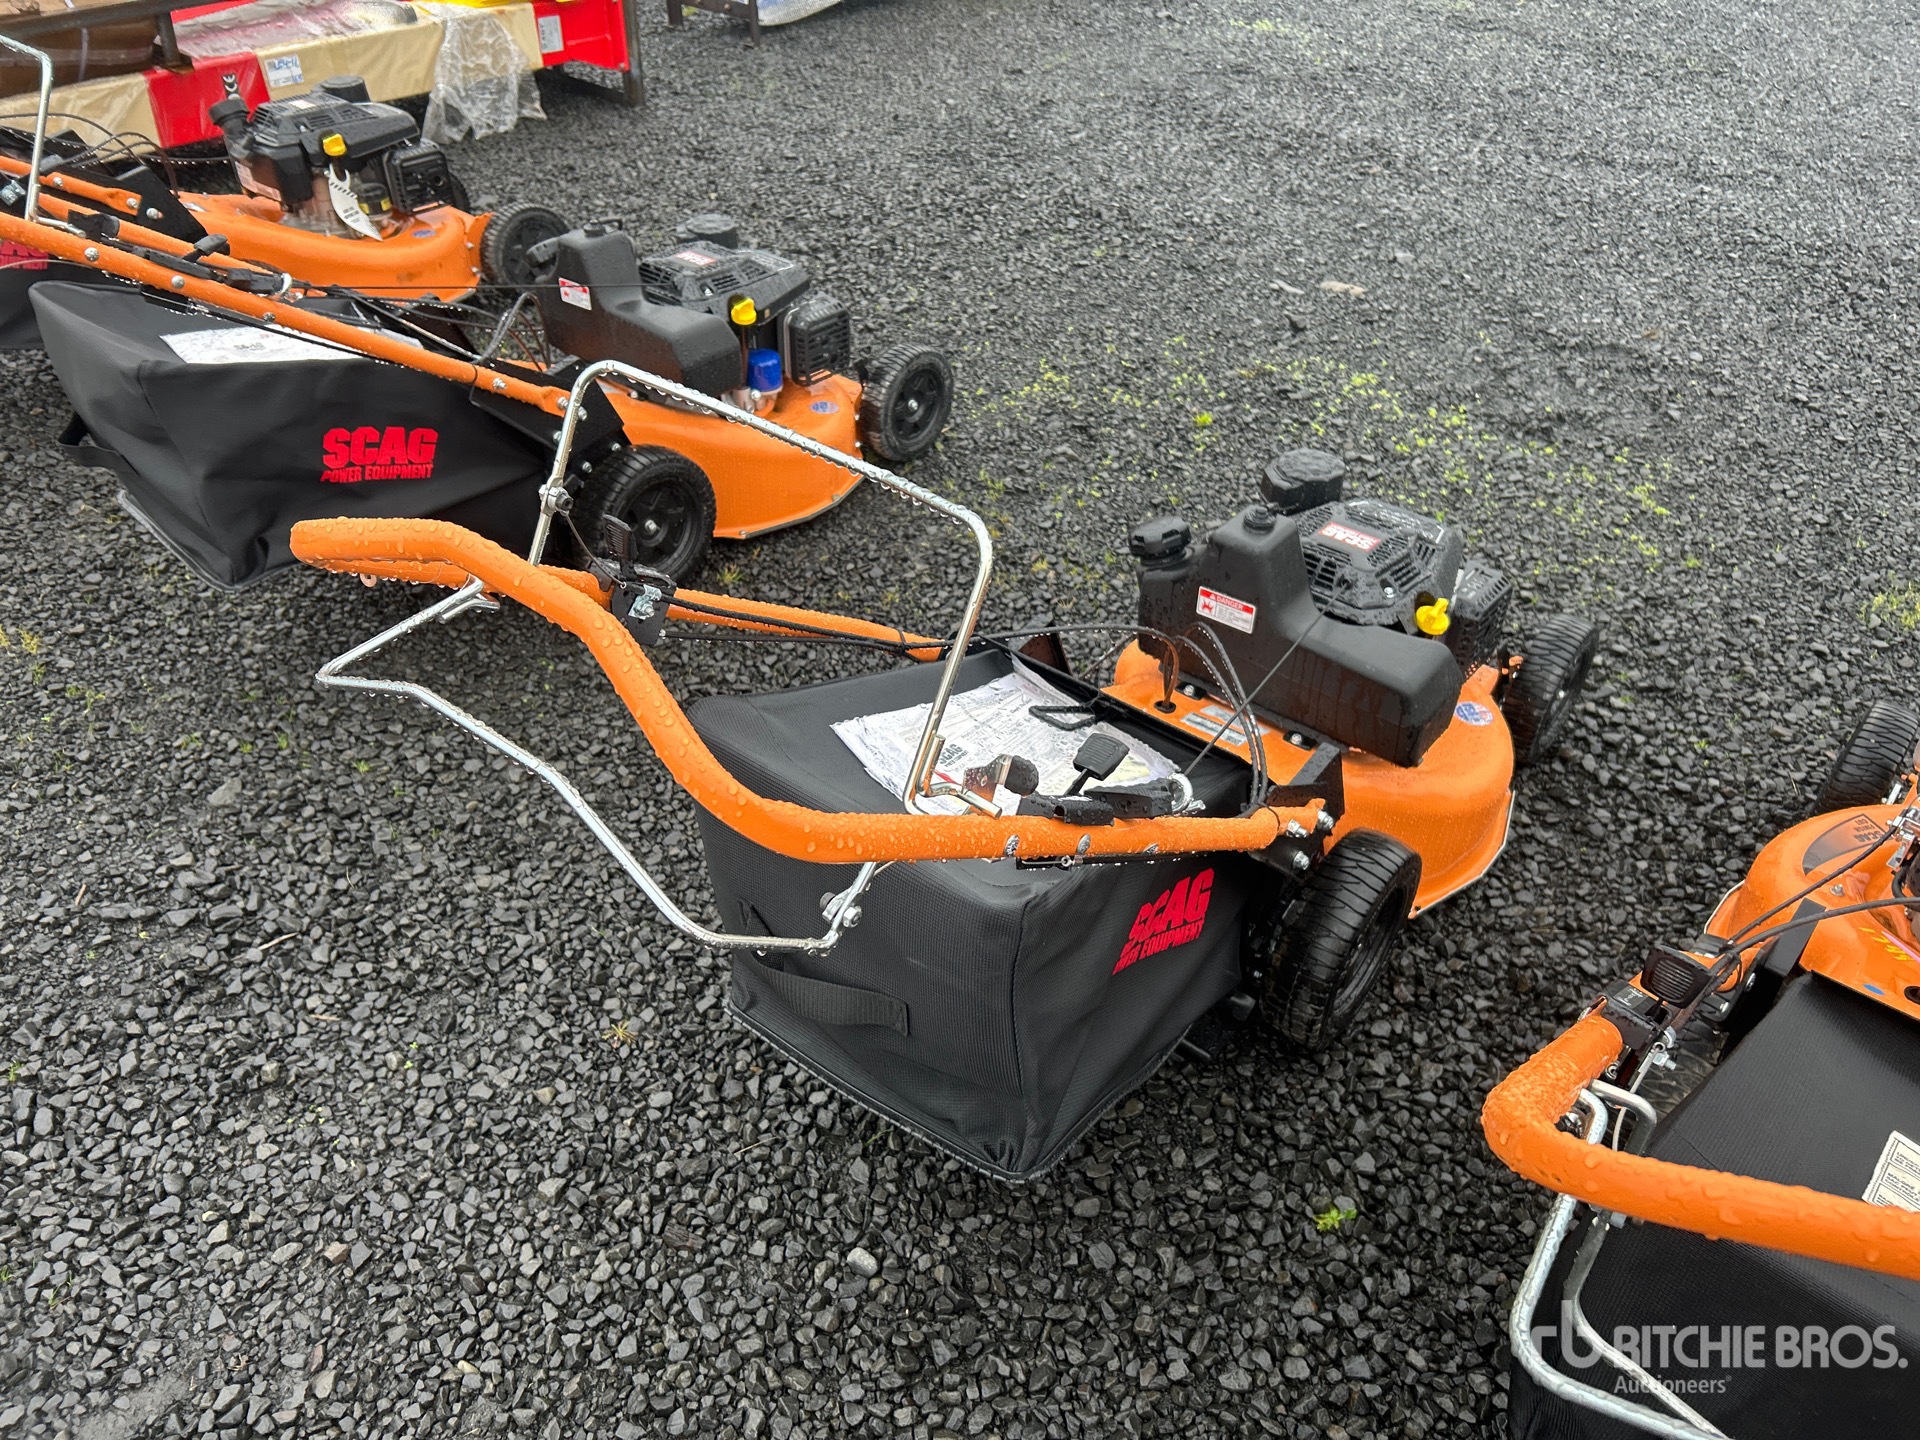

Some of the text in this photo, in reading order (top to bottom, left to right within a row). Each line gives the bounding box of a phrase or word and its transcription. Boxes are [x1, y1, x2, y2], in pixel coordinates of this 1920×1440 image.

[322, 426, 438, 470] SCAG
[320, 464, 434, 483] POWER EQUIPMENT
[1216, 595, 1244, 611] DANGER
[1128, 867, 1215, 943] SCAG
[1139, 916, 1206, 961] EQUIPMENT
